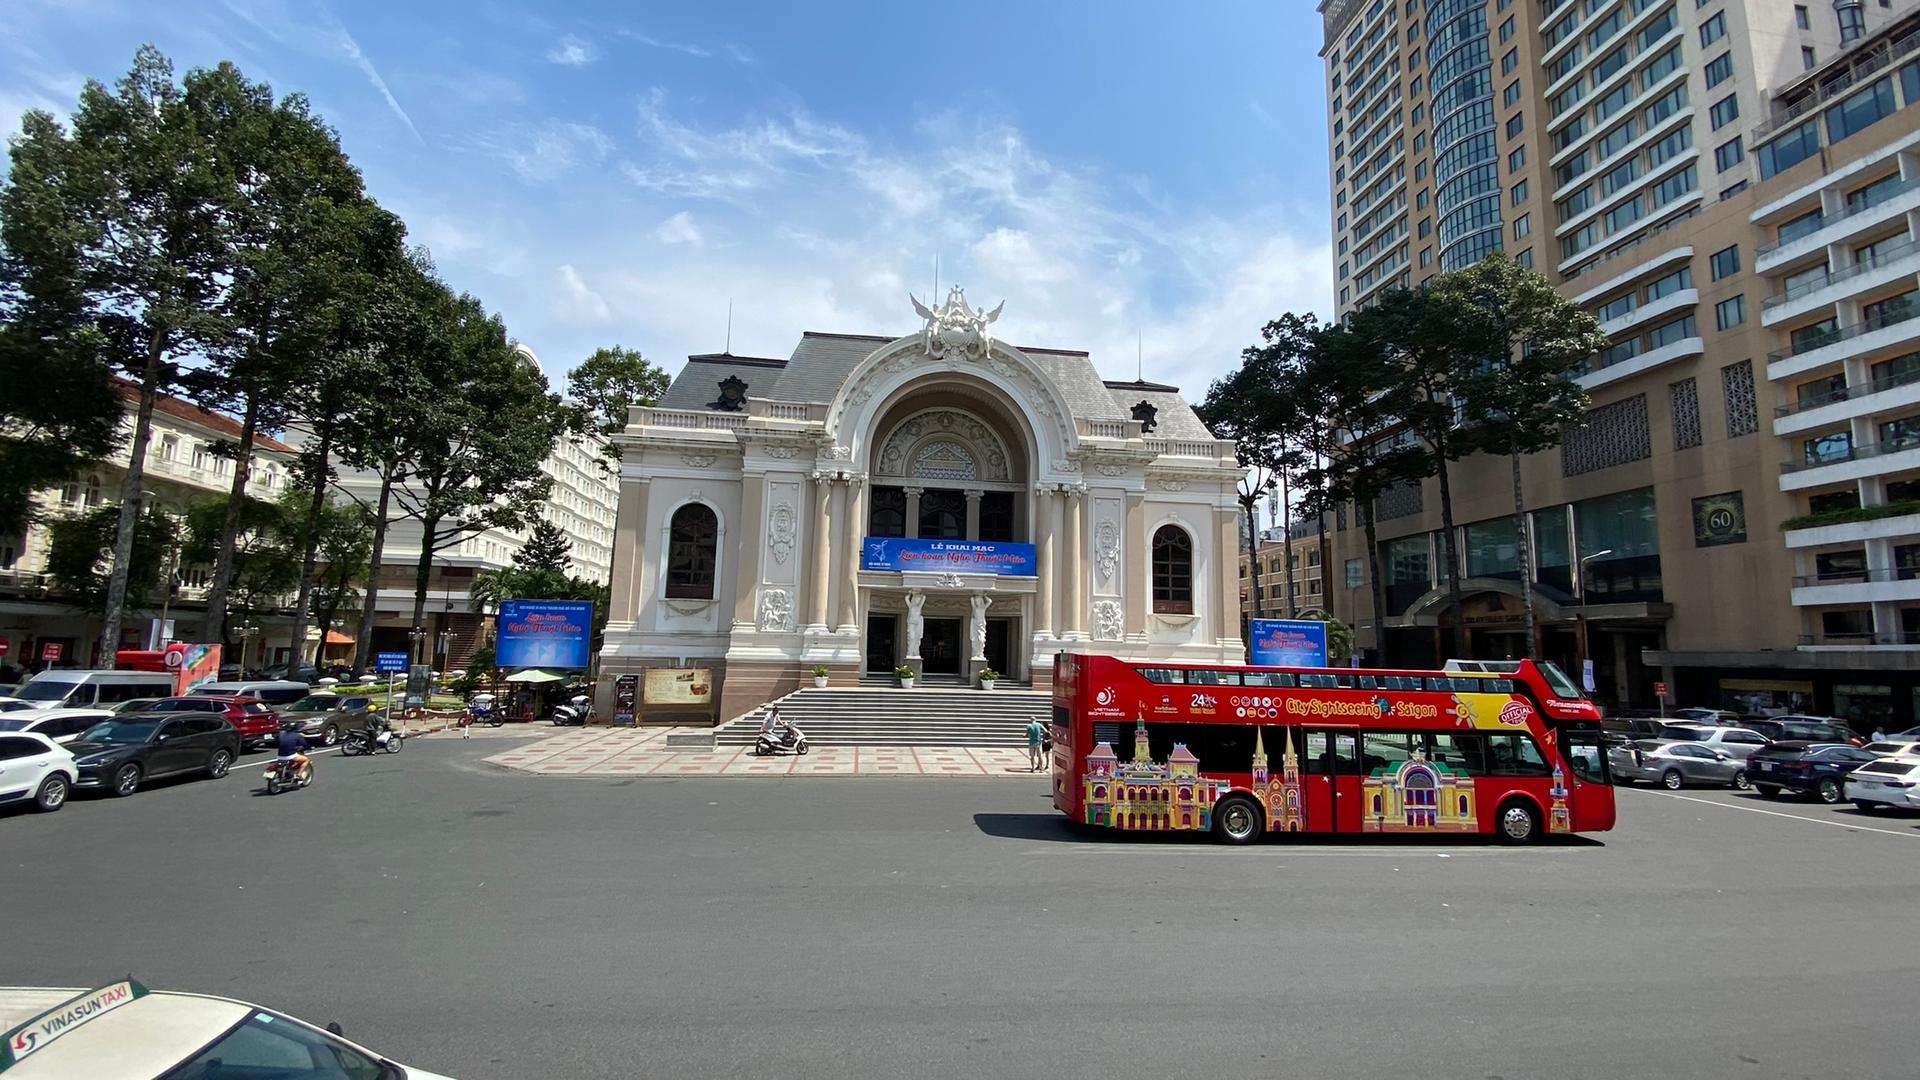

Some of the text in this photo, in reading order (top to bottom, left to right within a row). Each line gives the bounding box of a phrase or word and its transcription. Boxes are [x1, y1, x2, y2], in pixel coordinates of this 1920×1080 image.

[1710, 511, 1731, 529] 60
[1396, 700, 1438, 720] Saigon
[1500, 706, 1531, 722] OFFICIAL
[41, 985, 128, 1035] VINASUN TAXI
